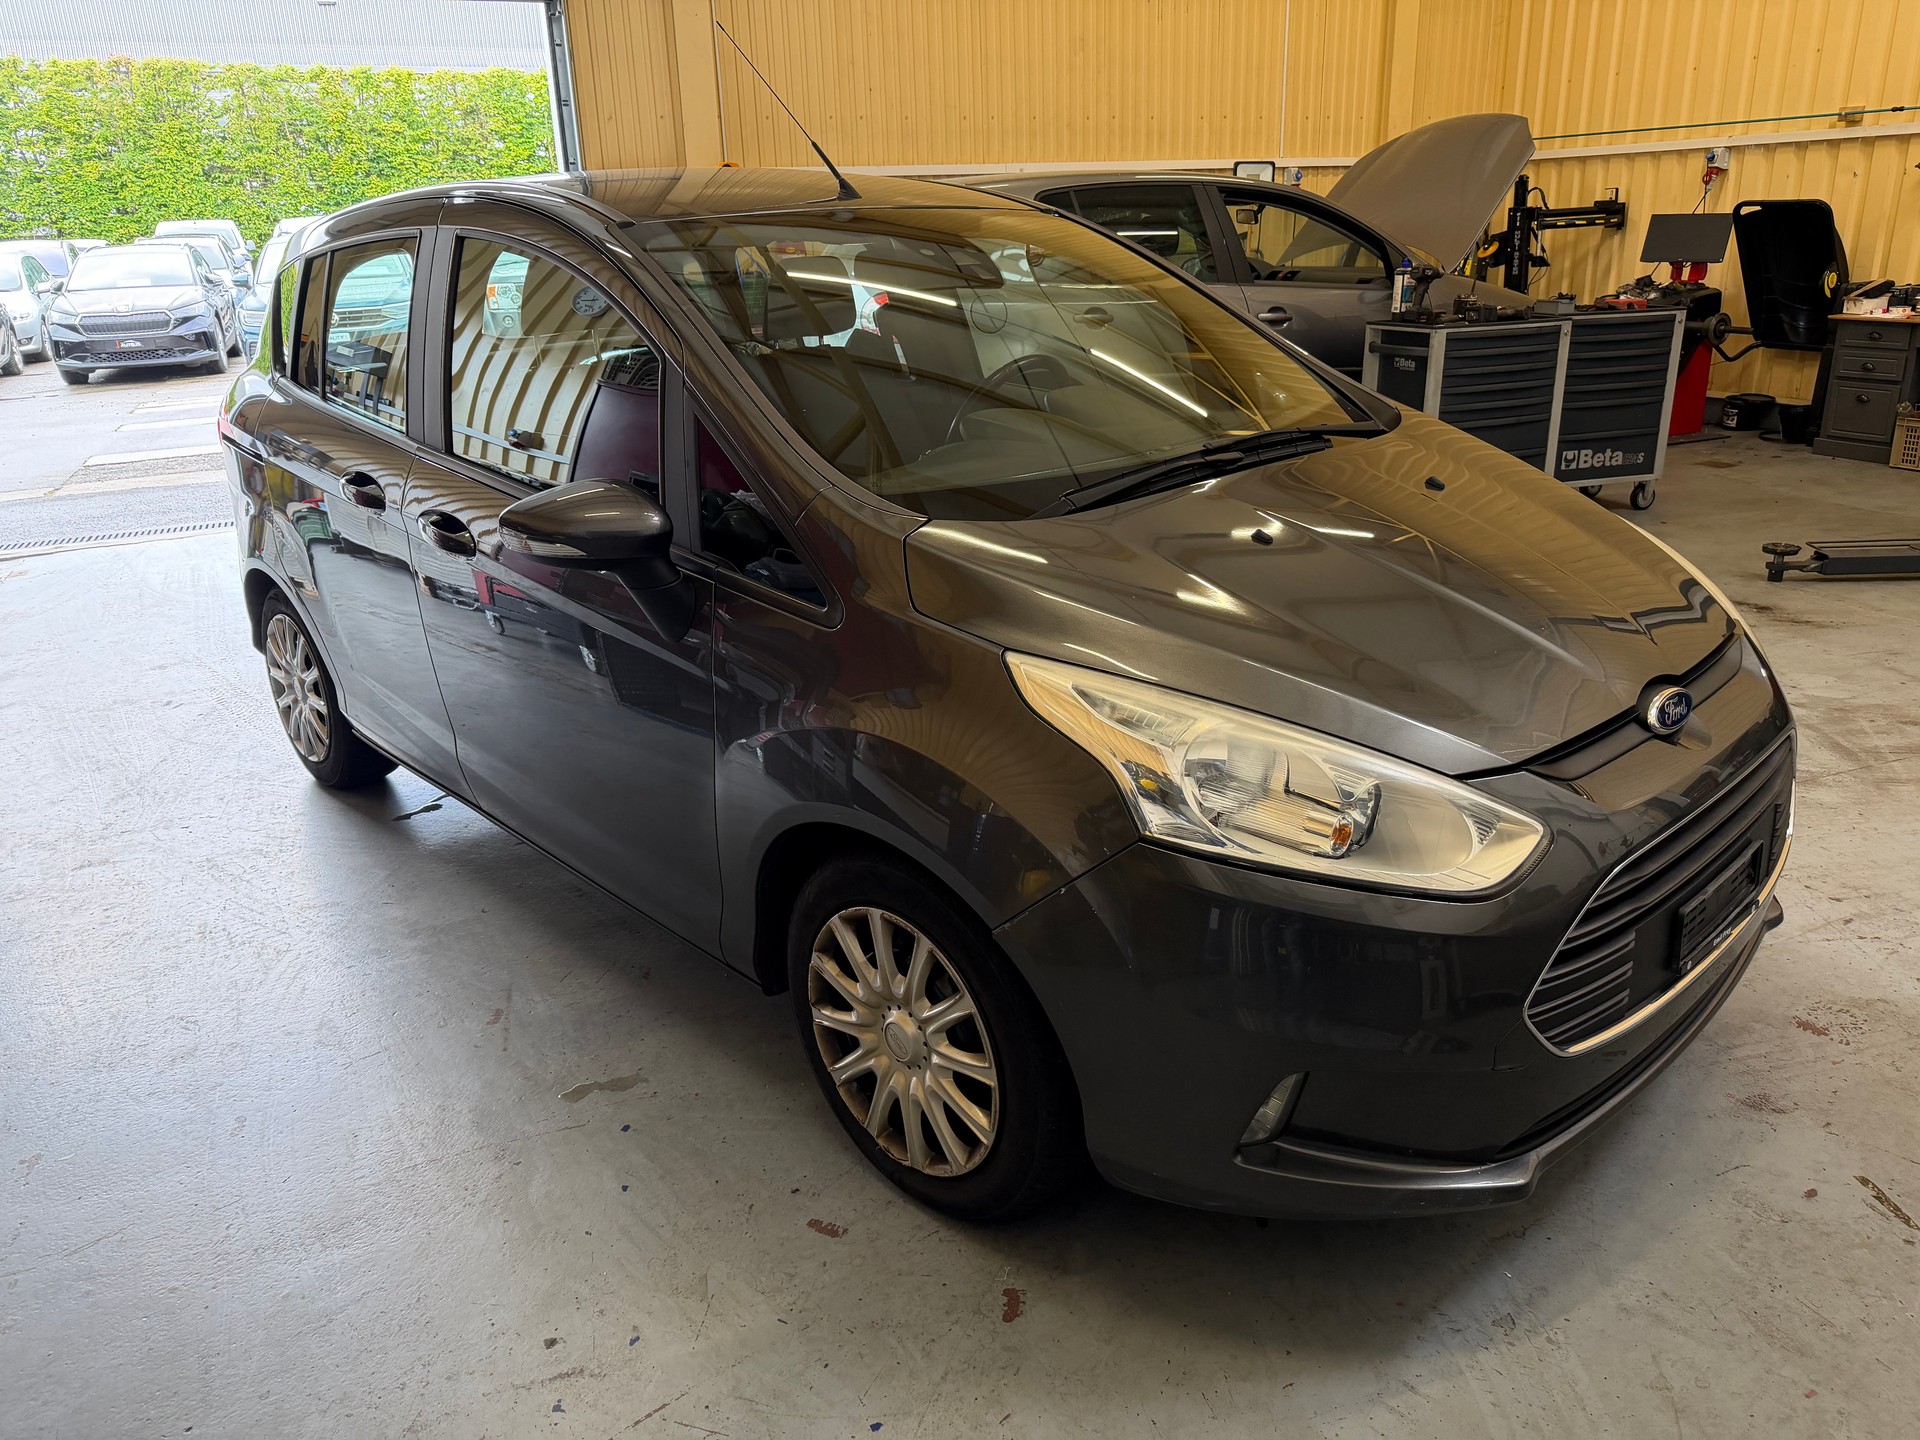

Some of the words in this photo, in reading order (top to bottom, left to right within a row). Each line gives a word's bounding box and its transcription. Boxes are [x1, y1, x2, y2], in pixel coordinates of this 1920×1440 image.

[1400, 358, 1416, 368] Beta
[1578, 448, 1623, 469] Beta
[1664, 696, 1688, 725] Ford
